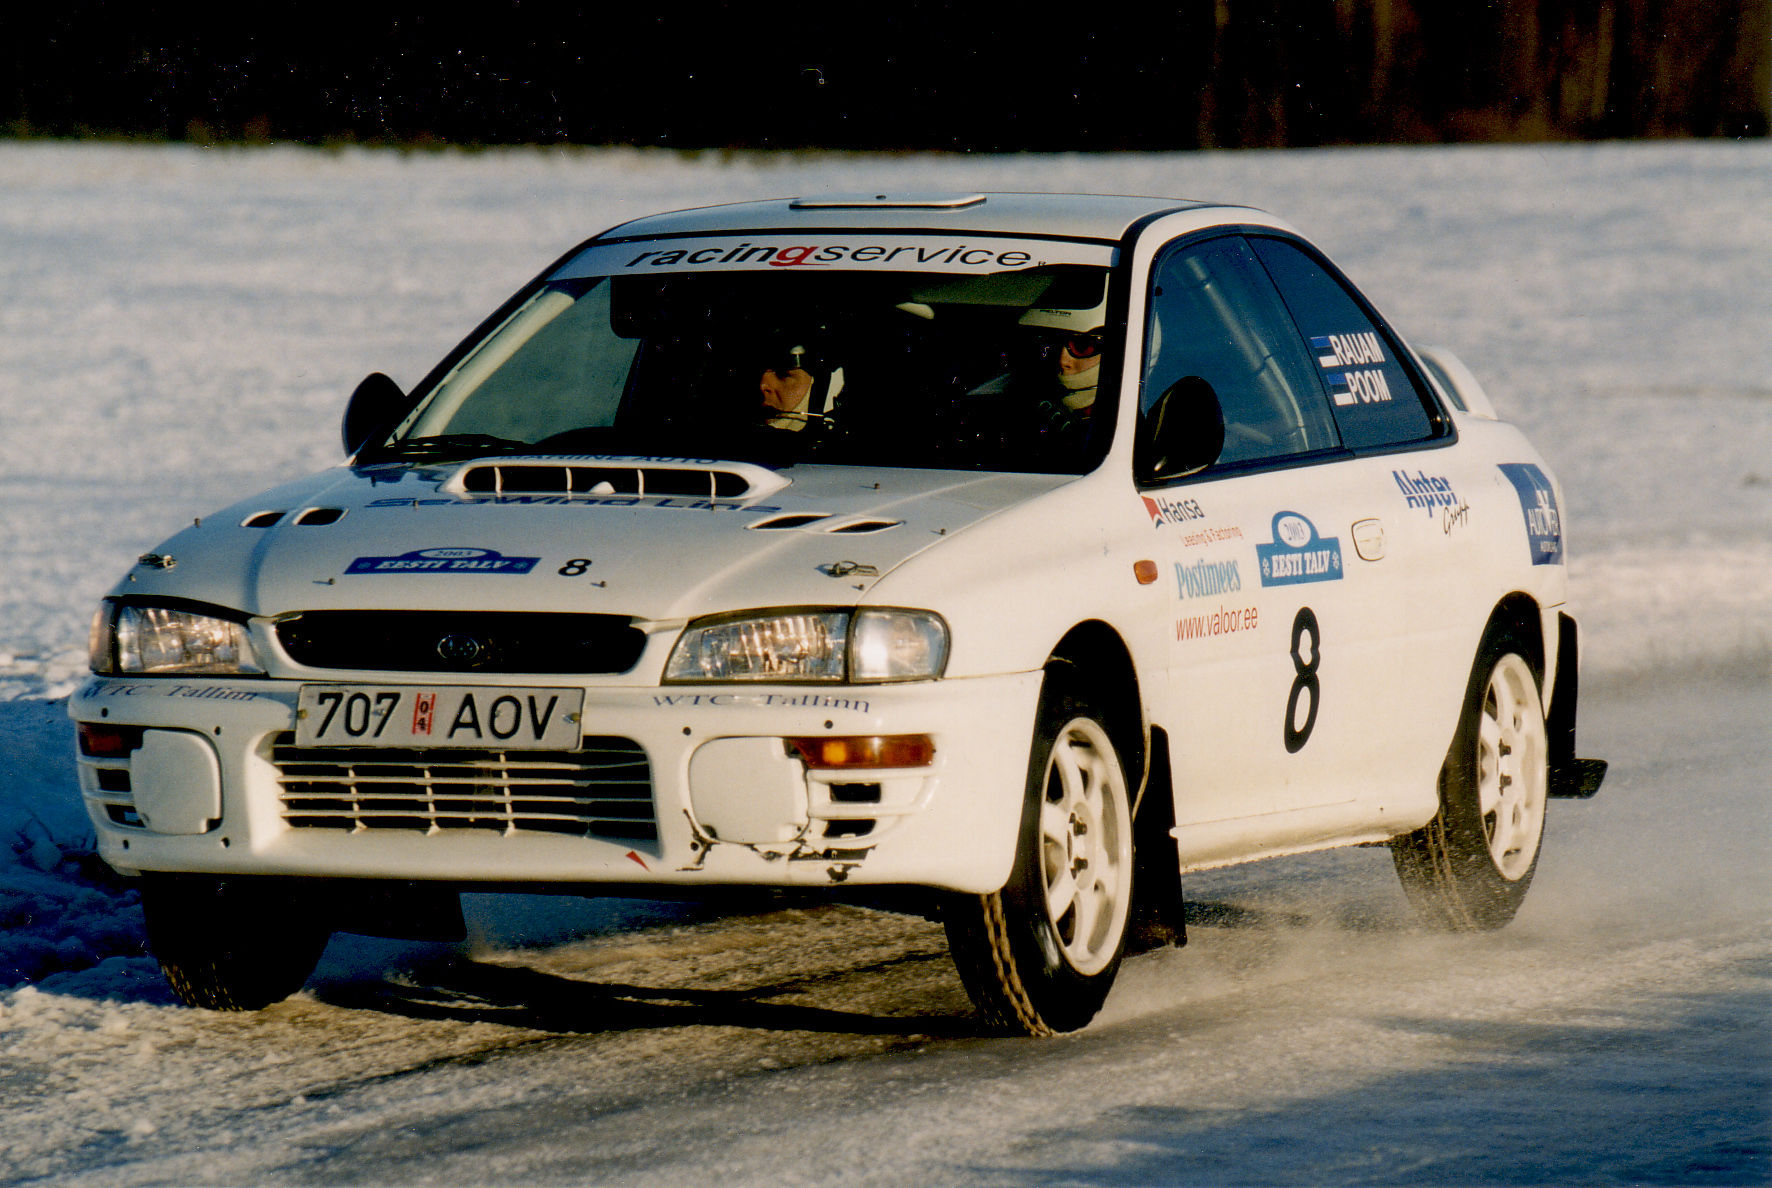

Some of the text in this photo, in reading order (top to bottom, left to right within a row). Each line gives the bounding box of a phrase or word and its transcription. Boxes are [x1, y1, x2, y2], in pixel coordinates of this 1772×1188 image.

[625, 243, 1032, 268] racingservice
[1328, 332, 1386, 366] RAUAM
[1345, 369, 1392, 404] POOM
[1157, 497, 1205, 524] Hansa
[374, 560, 511, 570] EESTI TALV
[558, 558, 592, 577] 8
[1271, 550, 1331, 578] EESTI TALV
[1174, 558, 1242, 600] Postimees
[1176, 604, 1259, 642] www.valoor.ee
[84, 683, 259, 701] WTC Tallinn
[1284, 606, 1321, 754] 8
[316, 692, 401, 738] 707
[448, 693, 558, 740] AOV
[653, 694, 870, 713] WTC Tallinn
